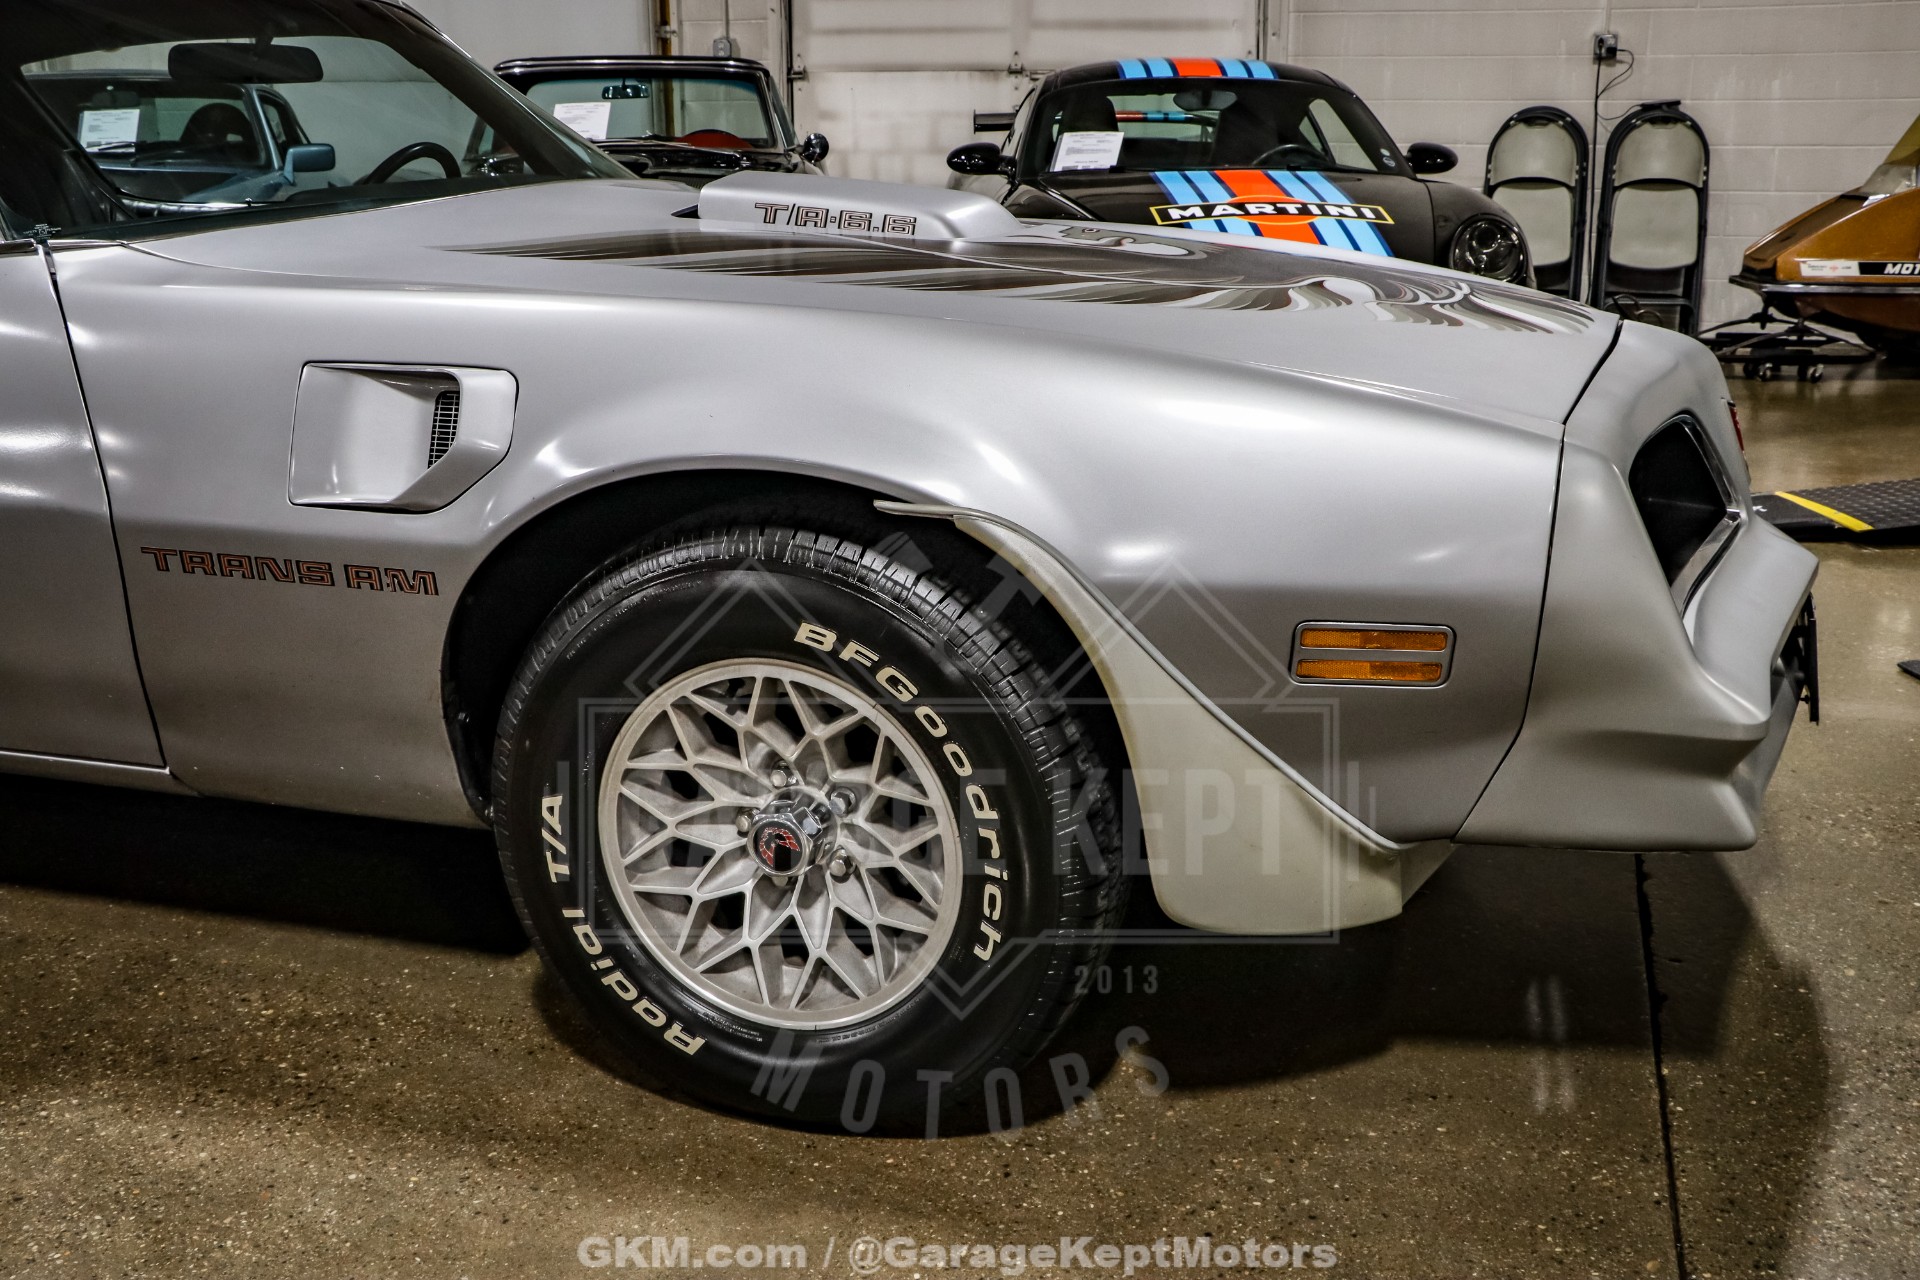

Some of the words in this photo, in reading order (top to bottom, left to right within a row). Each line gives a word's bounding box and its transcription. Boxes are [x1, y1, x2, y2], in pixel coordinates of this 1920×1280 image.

[1168, 203, 1376, 220] MARTINI
[140, 547, 335, 586] TRANS
[343, 564, 439, 596] AM
[794, 622, 1008, 961] BFGoodrich
[541, 795, 570, 883] T/A
[562, 908, 706, 1055] Radial
